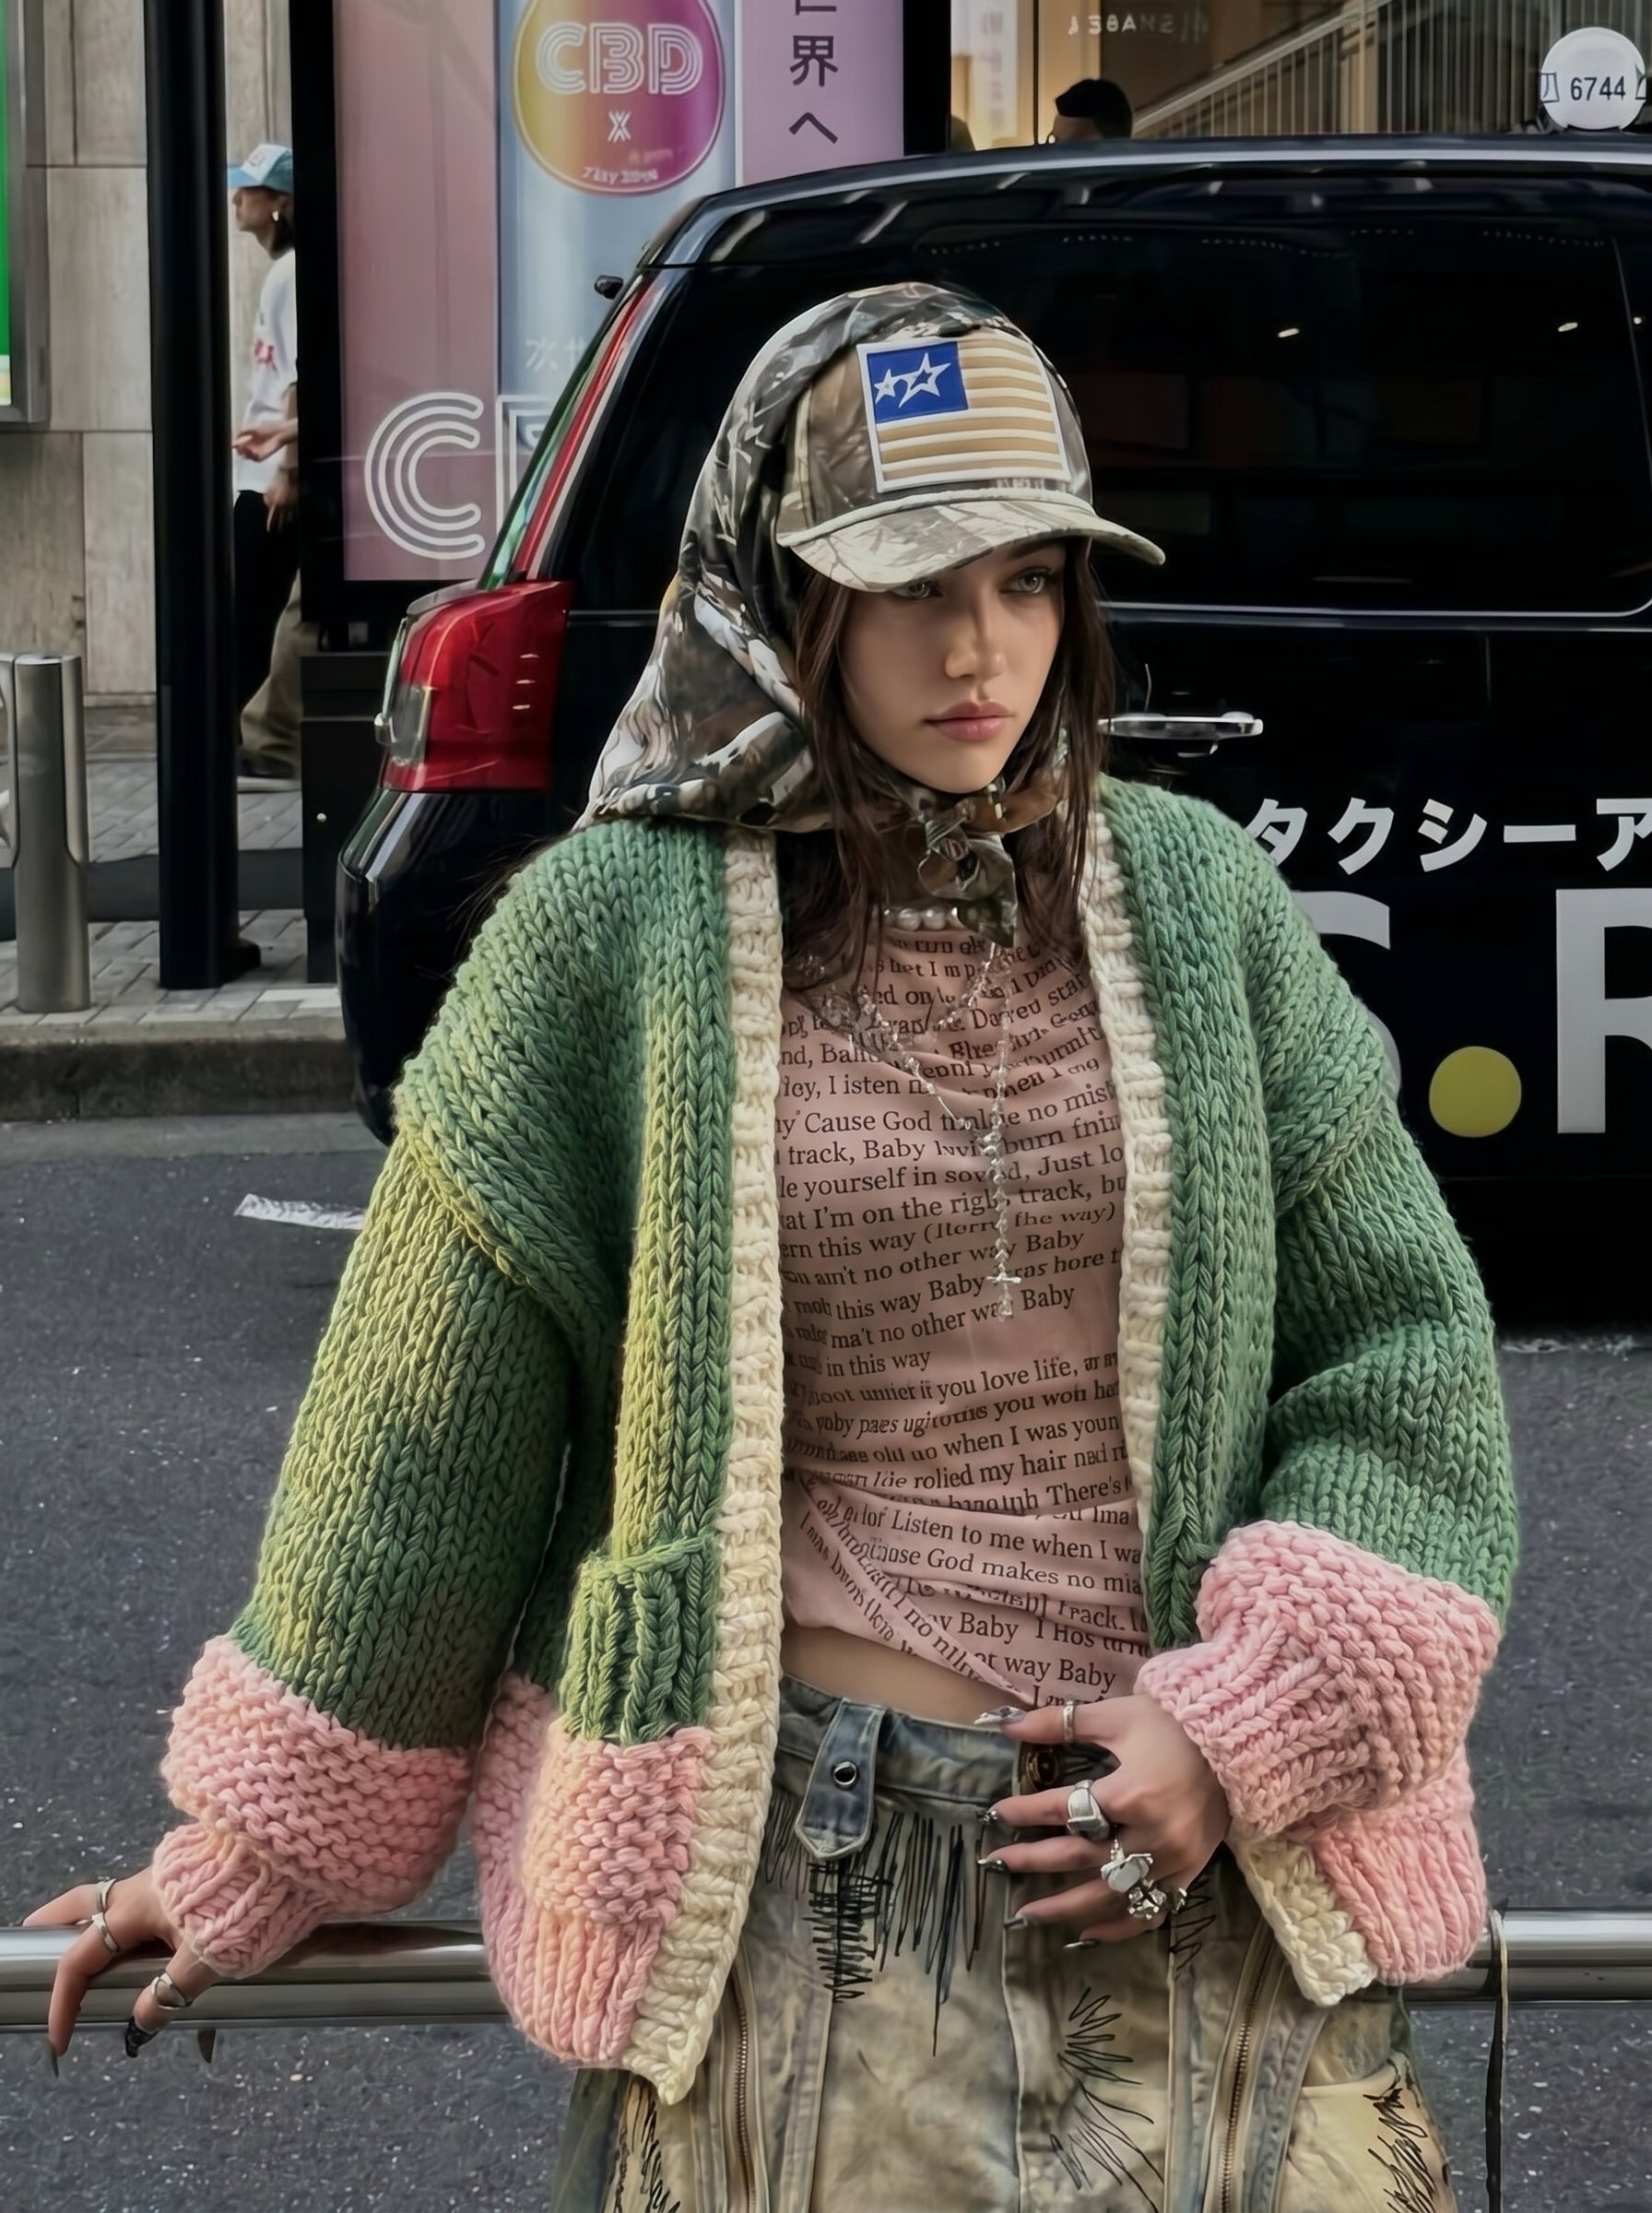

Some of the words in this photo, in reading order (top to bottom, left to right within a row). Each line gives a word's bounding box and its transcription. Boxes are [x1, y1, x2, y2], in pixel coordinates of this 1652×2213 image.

[535, 21, 704, 95] CBD
[1570, 76, 1627, 101] 6744
[805, 1113, 876, 1133] Cause
[883, 1111, 932, 1131] God
[1028, 1104, 1058, 1121] no
[788, 1142, 855, 1165] track,
[862, 1138, 926, 1161] Baby
[804, 1166, 907, 1201] yourself
[914, 1166, 937, 1187] in
[1038, 1151, 1094, 1177] Just
[862, 1206, 894, 1224] on
[902, 1197, 942, 1220] the
[1019, 1180, 1092, 1203] track,
[819, 1237, 862, 1257] this
[869, 1232, 916, 1251] way
[864, 1265, 892, 1283] no
[900, 1251, 962, 1273] other
[1026, 1231, 1085, 1253] Baby
[836, 1299, 875, 1320] this
[880, 1292, 921, 1313] way
[927, 1273, 985, 1301] Baby
[879, 1327, 904, 1343] no
[911, 1311, 966, 1337] other
[1021, 1284, 1075, 1310] Baby
[849, 1354, 886, 1376] this
[892, 1351, 931, 1371] way
[938, 1378, 977, 1404] you
[981, 1369, 1030, 1391] love
[994, 1394, 1035, 1421] you
[944, 1433, 1005, 1456] when
[1010, 1426, 1020, 1446] I
[1024, 1422, 1068, 1442] was
[979, 1462, 1014, 1485] my
[1020, 1450, 1067, 1476] hair
[891, 1509, 953, 1540] Listen
[962, 1524, 982, 1544] to
[989, 1531, 1025, 1550] me
[1032, 1533, 1093, 1558] when
[1100, 1539, 1108, 1559] I
[927, 1548, 974, 1573] God
[982, 1561, 1059, 1585] makes
[1068, 1574, 1094, 1589] no
[959, 1612, 1019, 1644] Baby
[1005, 1656, 1051, 1682] way
[1057, 1659, 1117, 1693] Baby
